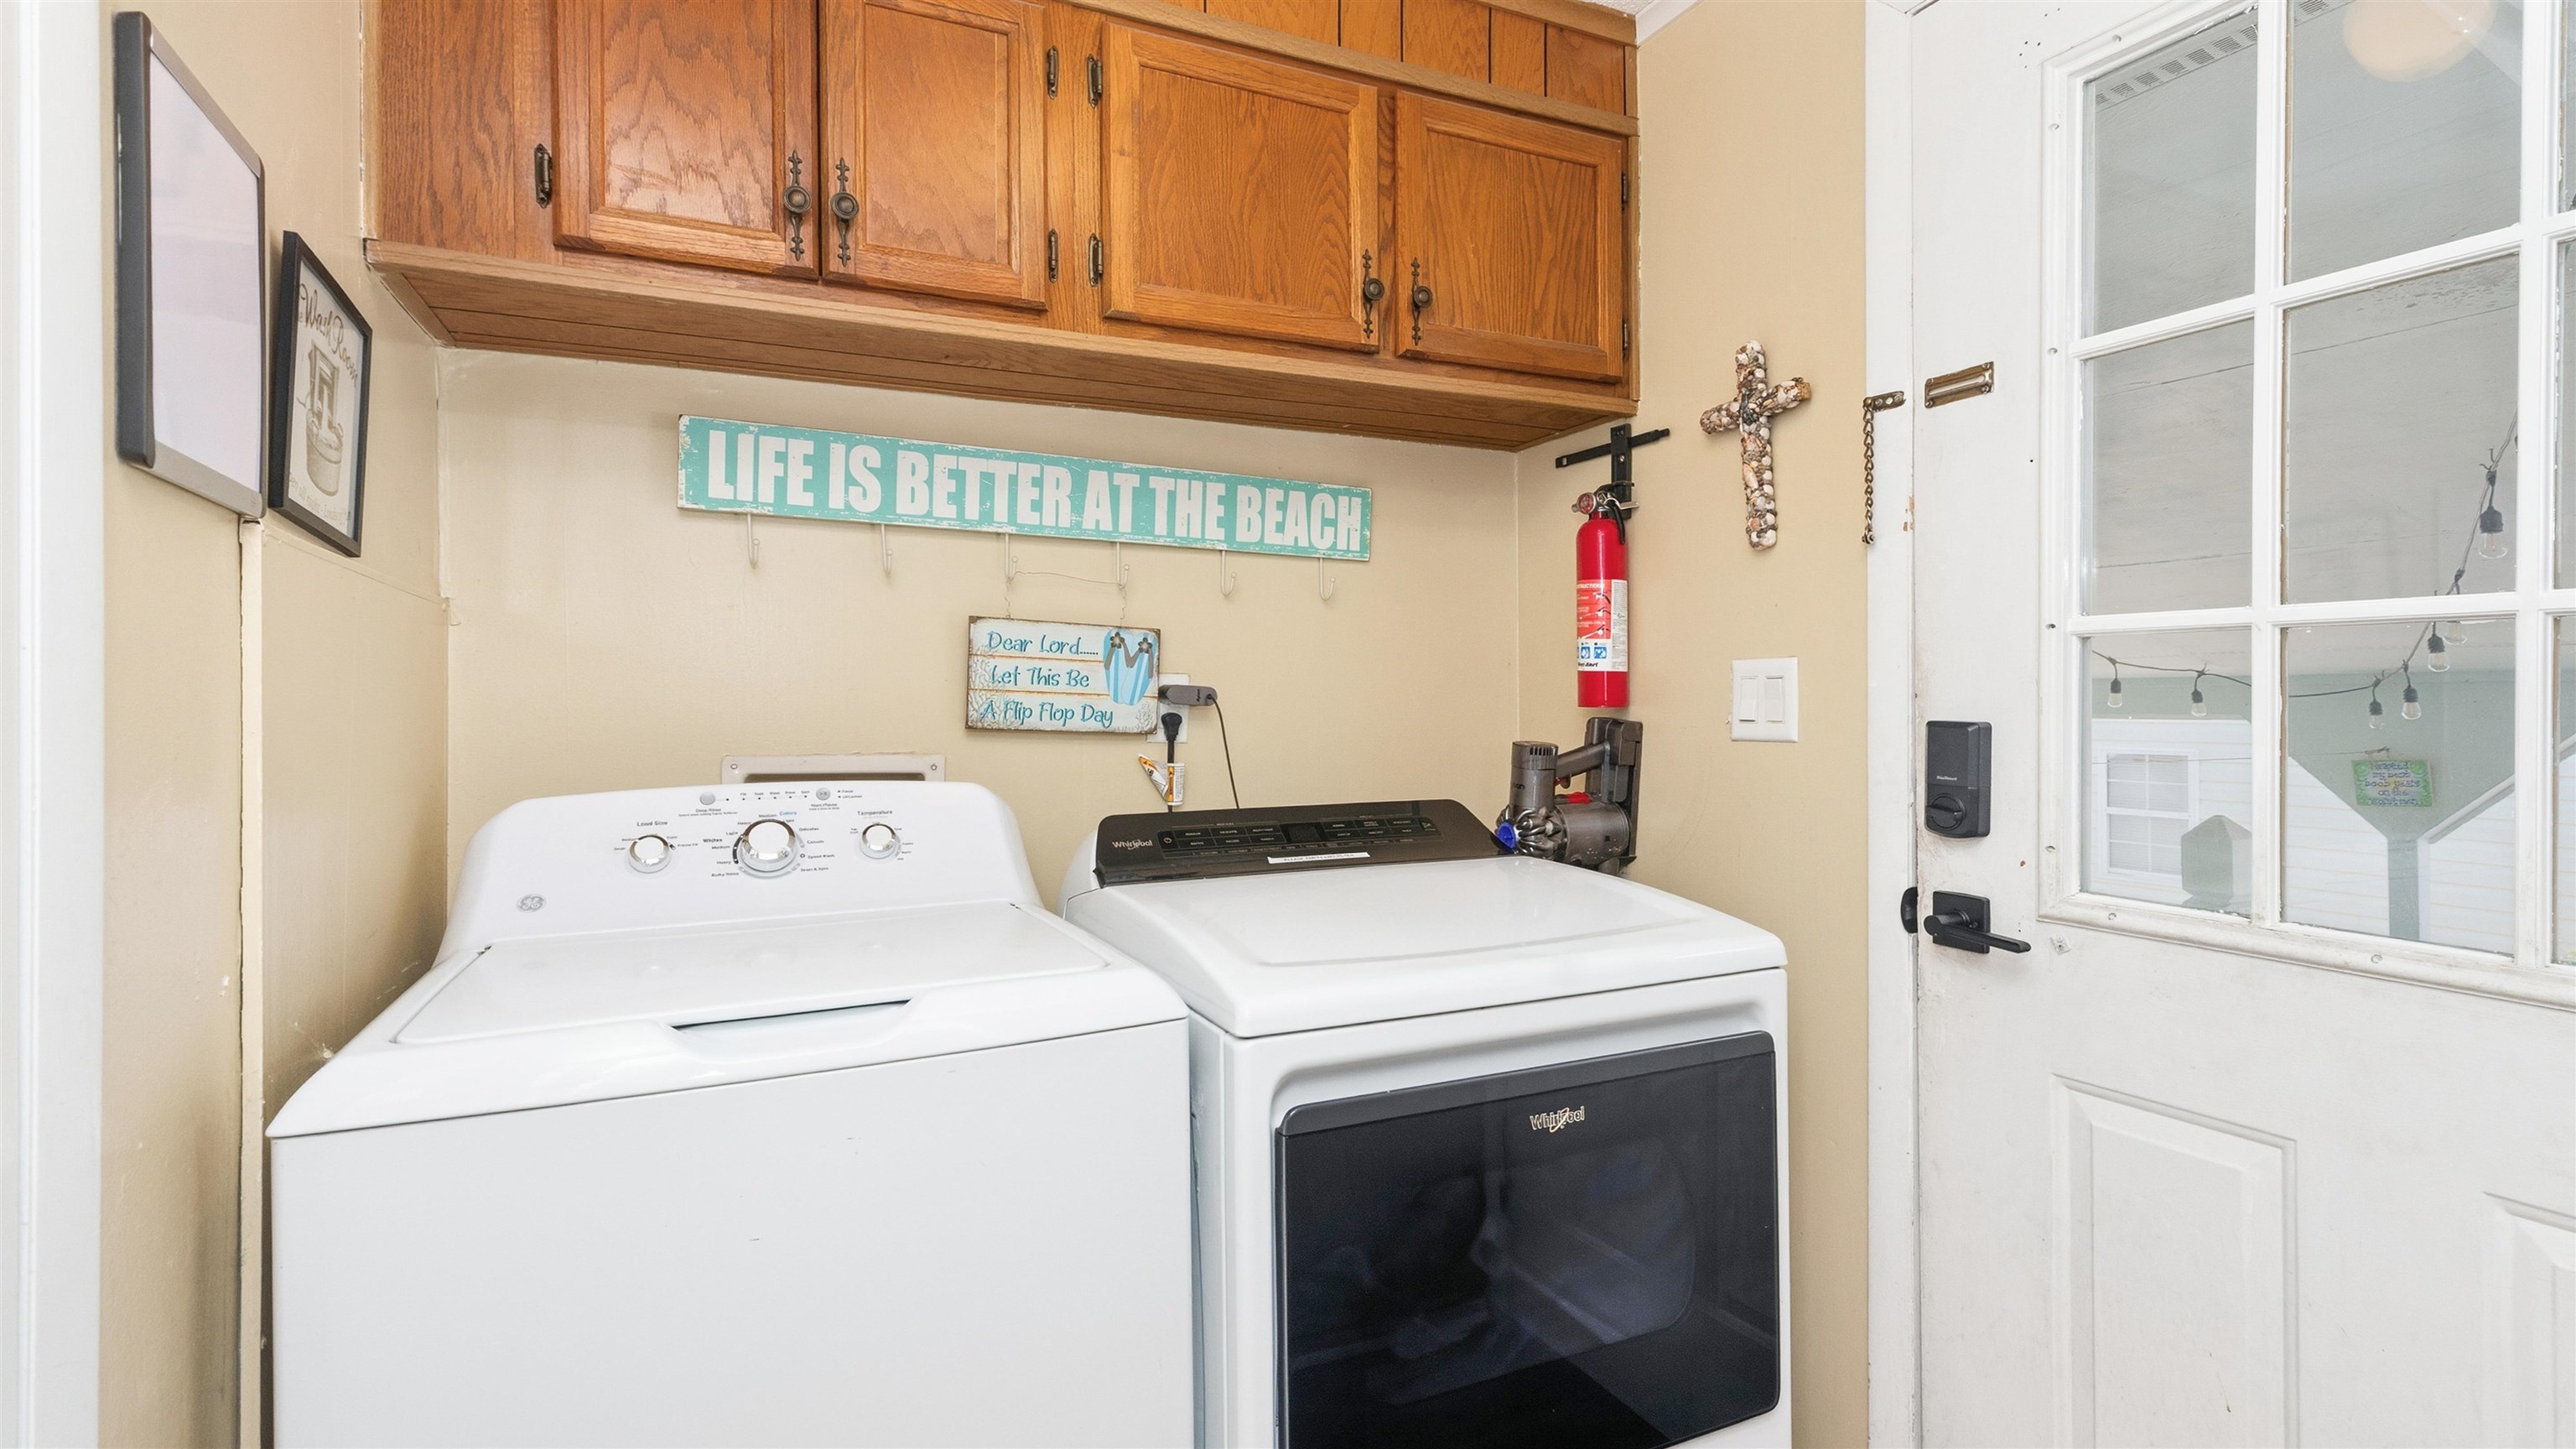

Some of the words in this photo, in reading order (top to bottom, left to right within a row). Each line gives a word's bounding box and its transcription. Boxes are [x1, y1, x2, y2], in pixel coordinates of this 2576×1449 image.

[708, 430, 813, 505] LIFE
[829, 441, 882, 512] IS
[896, 449, 1072, 527] BETTER
[1083, 470, 1145, 533] AT
[1147, 475, 1226, 540] THE
[1235, 485, 1362, 551] BEACH
[987, 631, 1032, 653] Dear
[990, 665, 1021, 686] Let
[1026, 667, 1061, 687] This
[1066, 668, 1090, 688] Be
[979, 700, 997, 720] A
[1004, 701, 1033, 725] Flip
[1039, 704, 1075, 727] Flop
[1080, 705, 1114, 729] Day
[1112, 839, 1153, 850] Whirlpool
[1530, 1106, 1585, 1132] Whirlpool
